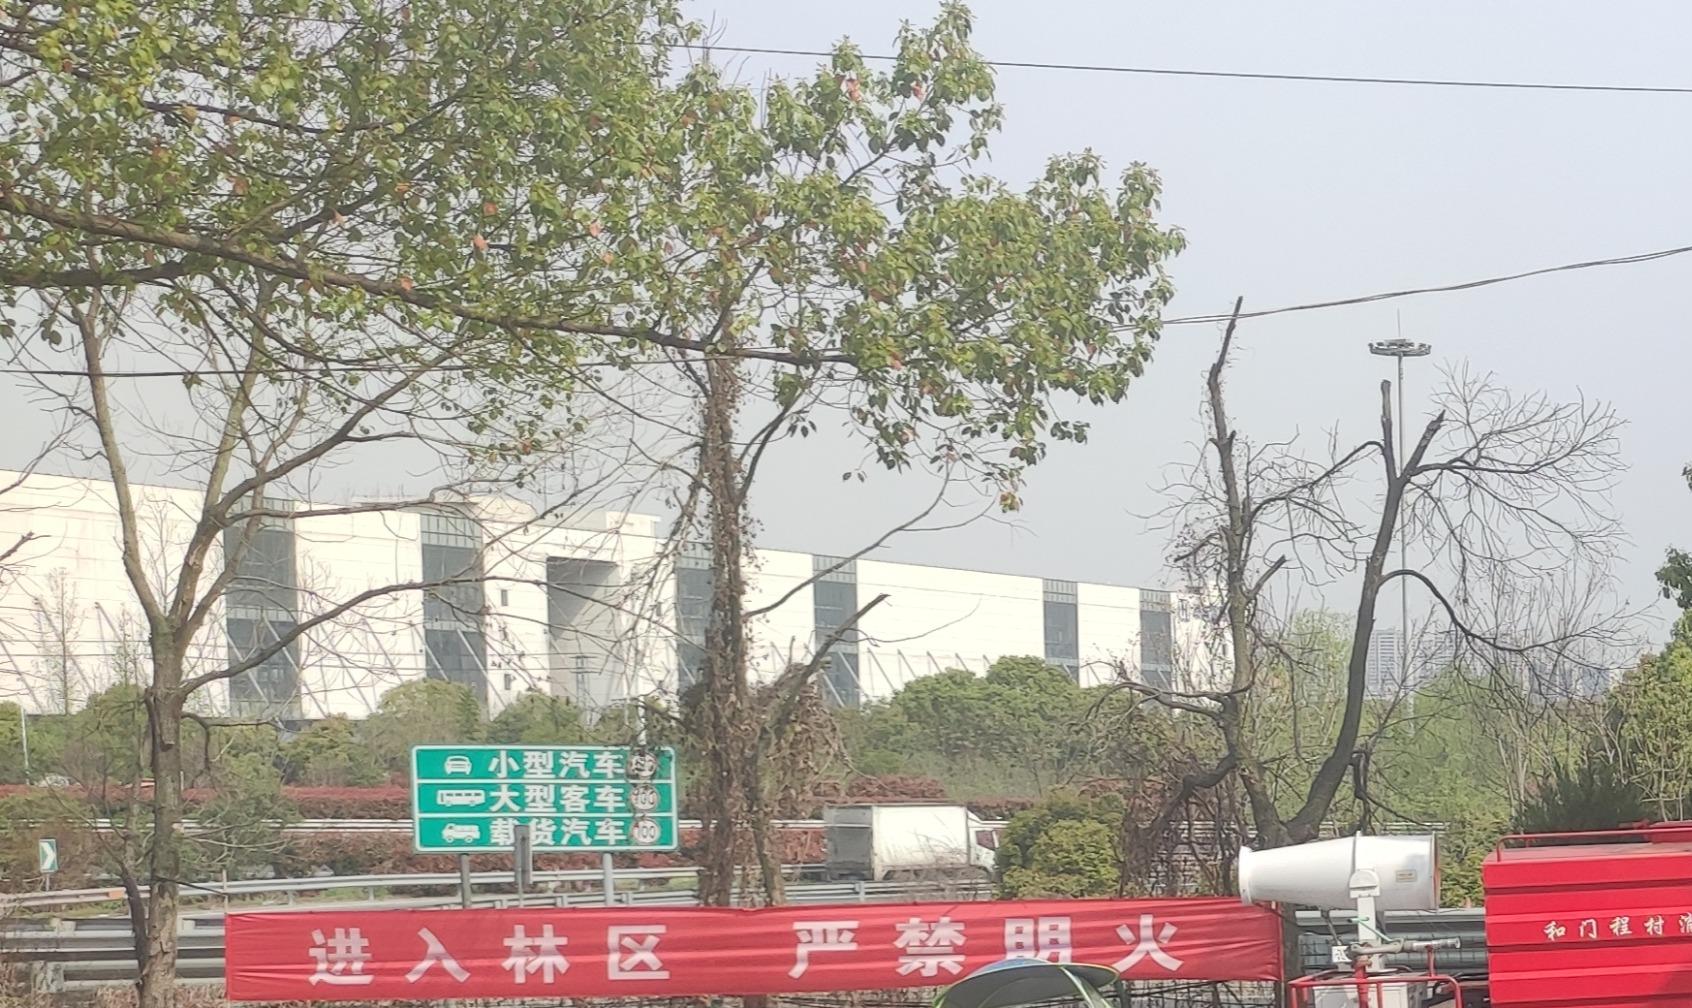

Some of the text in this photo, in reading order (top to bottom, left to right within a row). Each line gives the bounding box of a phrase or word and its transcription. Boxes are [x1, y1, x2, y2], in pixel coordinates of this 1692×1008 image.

[488, 751, 625, 777] 小型汽车
[490, 785, 626, 812] 大型客车
[490, 819, 627, 845] 载货汽车
[308, 913, 1184, 986] 进入林区 严禁明火
